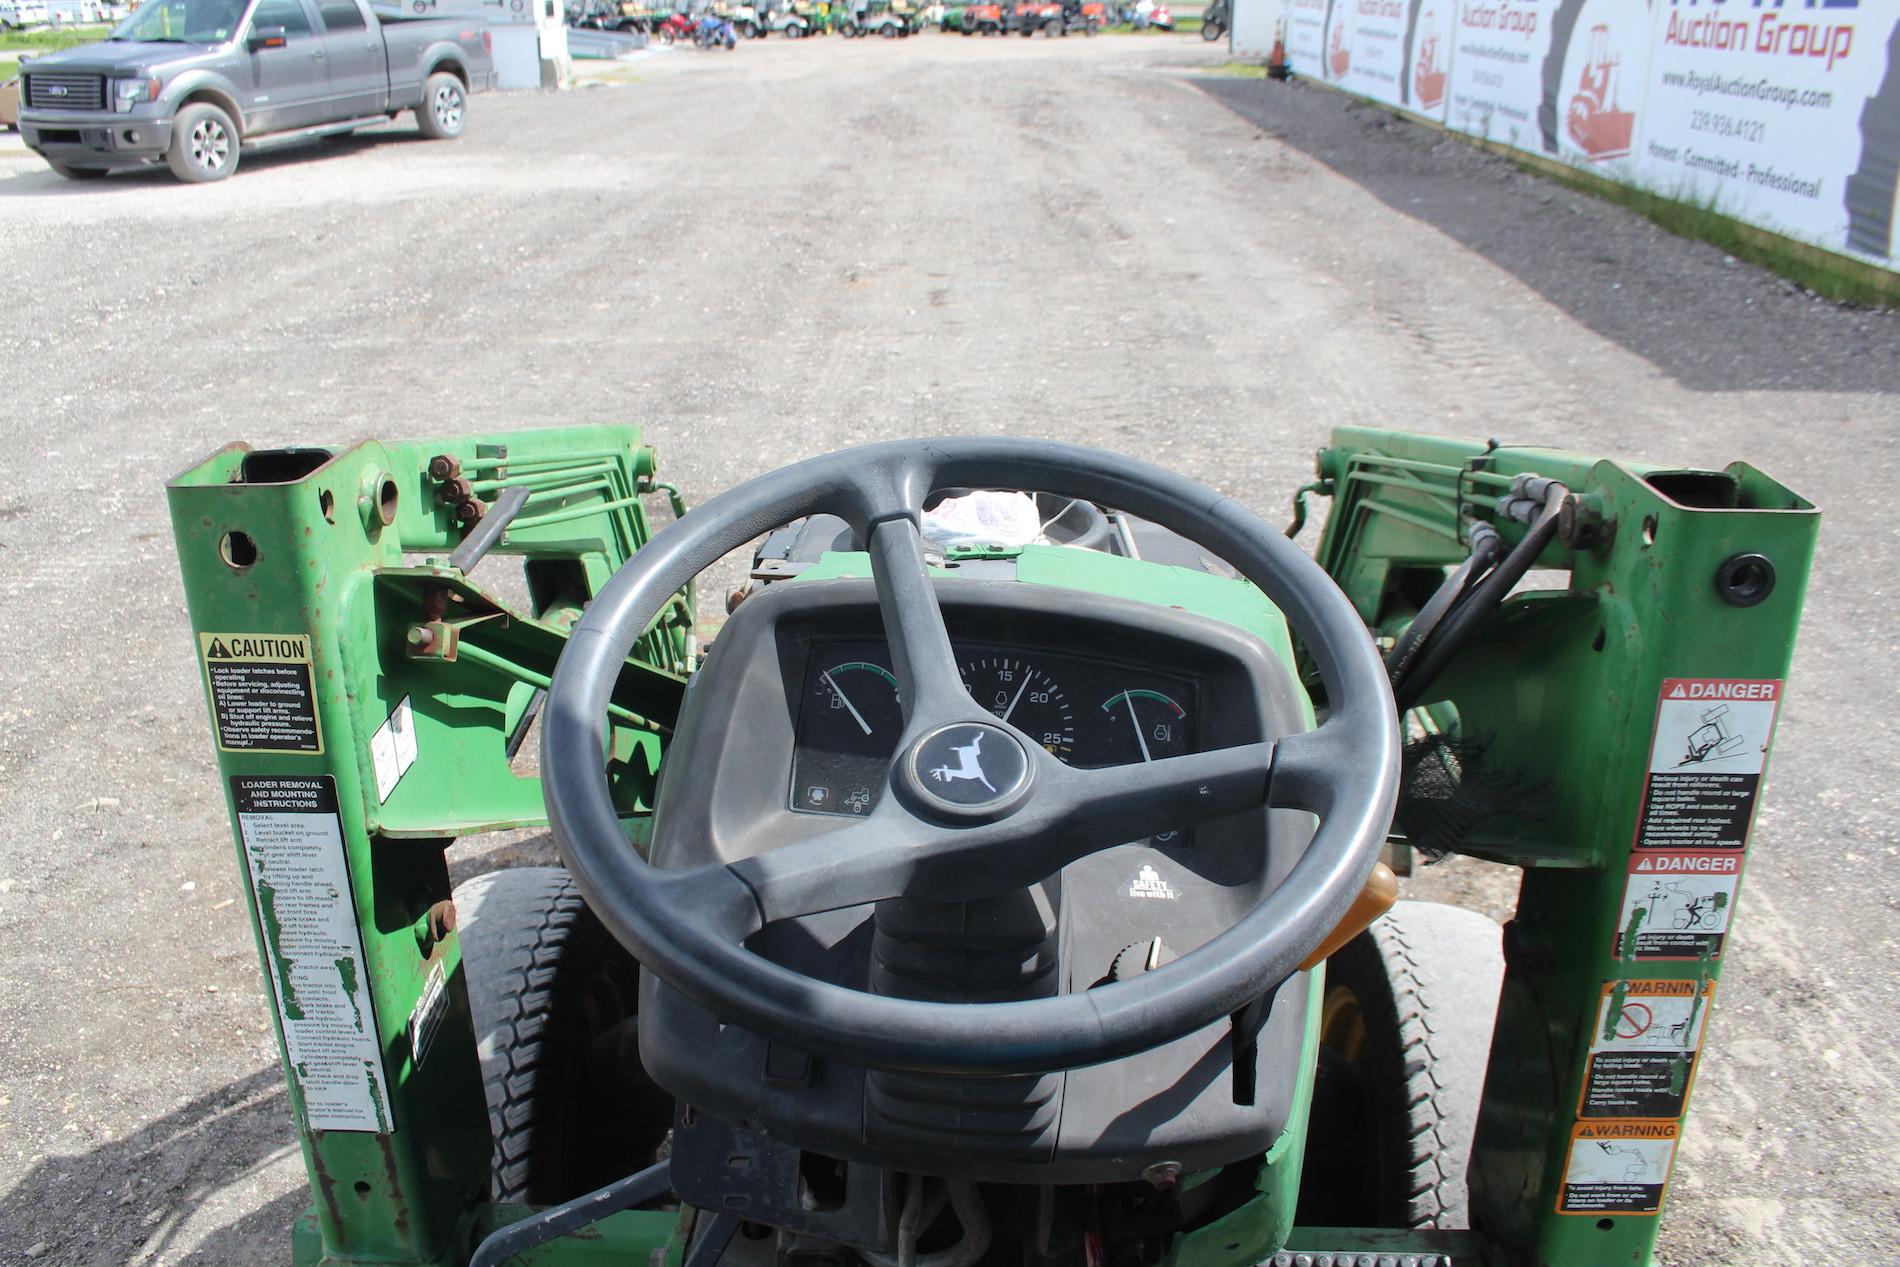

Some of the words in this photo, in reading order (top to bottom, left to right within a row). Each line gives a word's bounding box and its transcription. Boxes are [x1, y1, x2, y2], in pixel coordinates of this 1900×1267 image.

[1665, 10, 1748, 51] Auction
[1755, 13, 1853, 72] Group
[1662, 70, 1832, 109] www.RoyalAuctionGroup.com
[1691, 110, 1764, 143] 239.936.4121
[1648, 141, 1677, 162] Honest
[1683, 149, 1739, 178] Committed
[1747, 164, 1822, 199] Professional
[232, 639, 304, 658] CAUTION
[998, 671, 1012, 681] 15
[1030, 692, 1048, 703] 20
[1689, 683, 1774, 698] DANGER
[1044, 733, 1061, 744] 25
[1656, 857, 1736, 870] DANGER
[1133, 880, 1167, 890] SAFETY
[1596, 1126, 1675, 1136] WARNING
